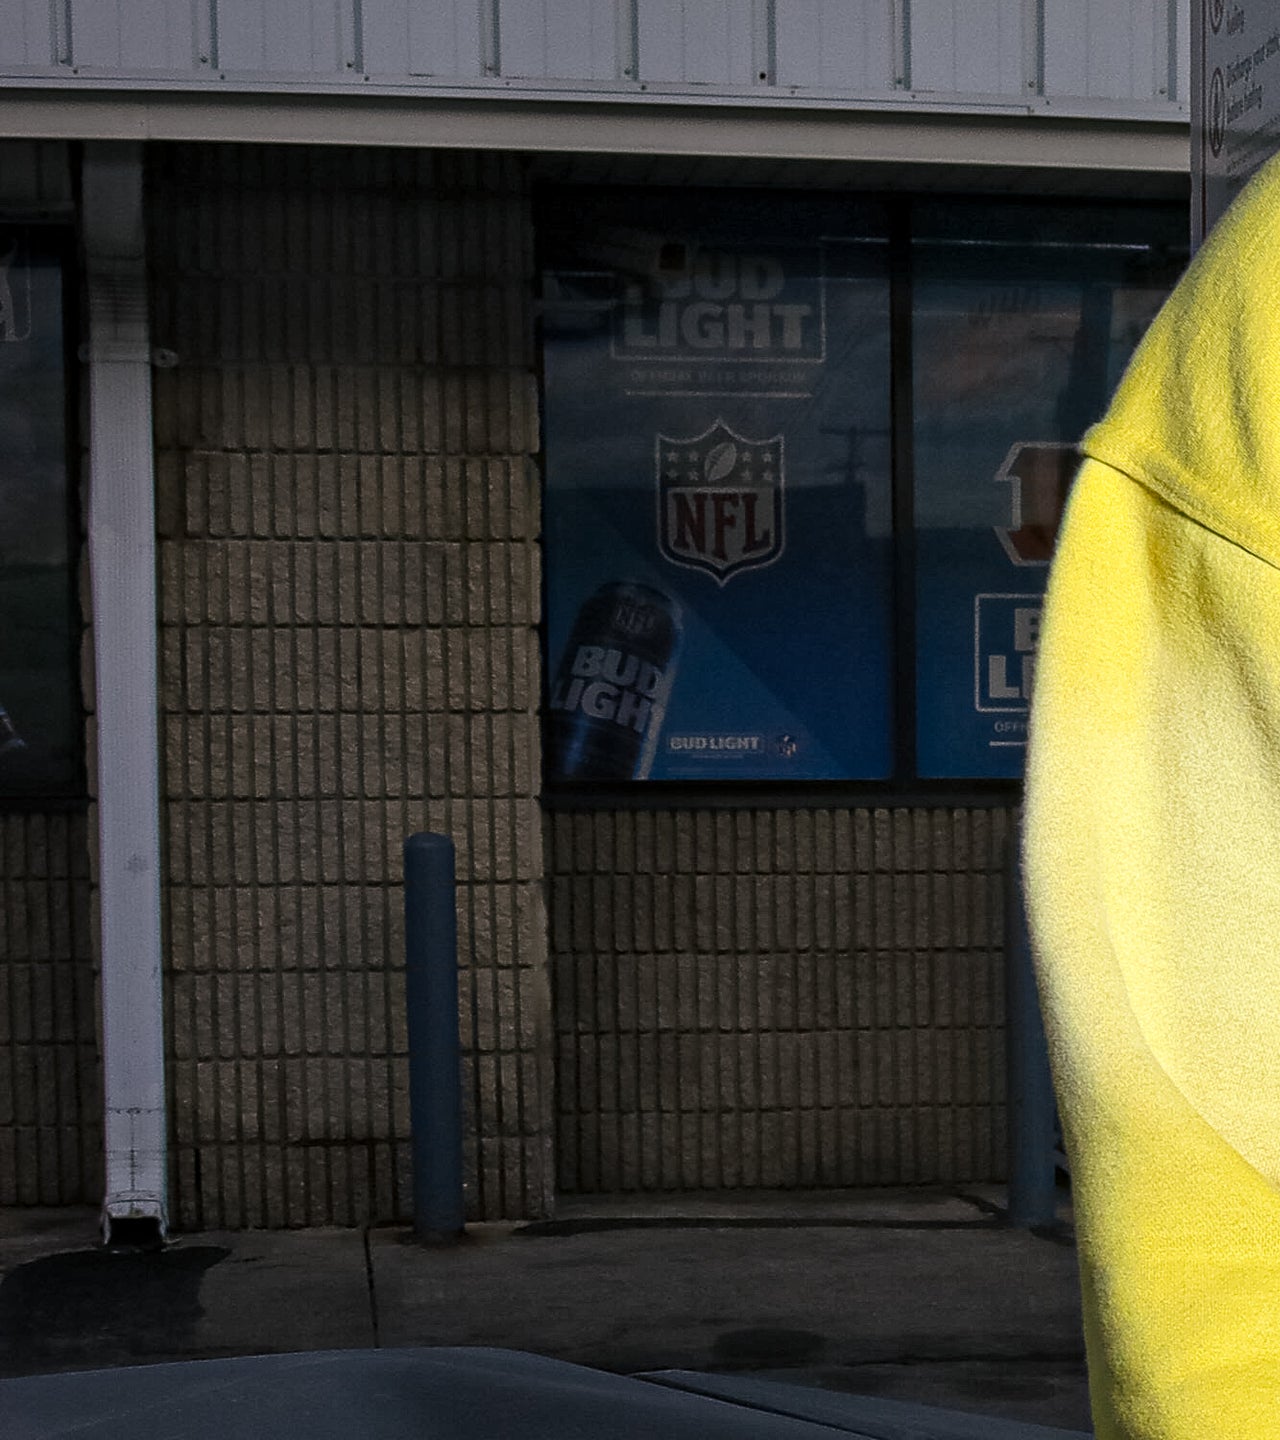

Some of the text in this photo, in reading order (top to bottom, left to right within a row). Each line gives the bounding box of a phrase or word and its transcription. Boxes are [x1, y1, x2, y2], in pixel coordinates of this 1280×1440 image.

[623, 301, 812, 349] LIGHT
[672, 493, 771, 561] NFL
[571, 645, 663, 699] BUD
[670, 736, 760, 750] BUD LIGHT
